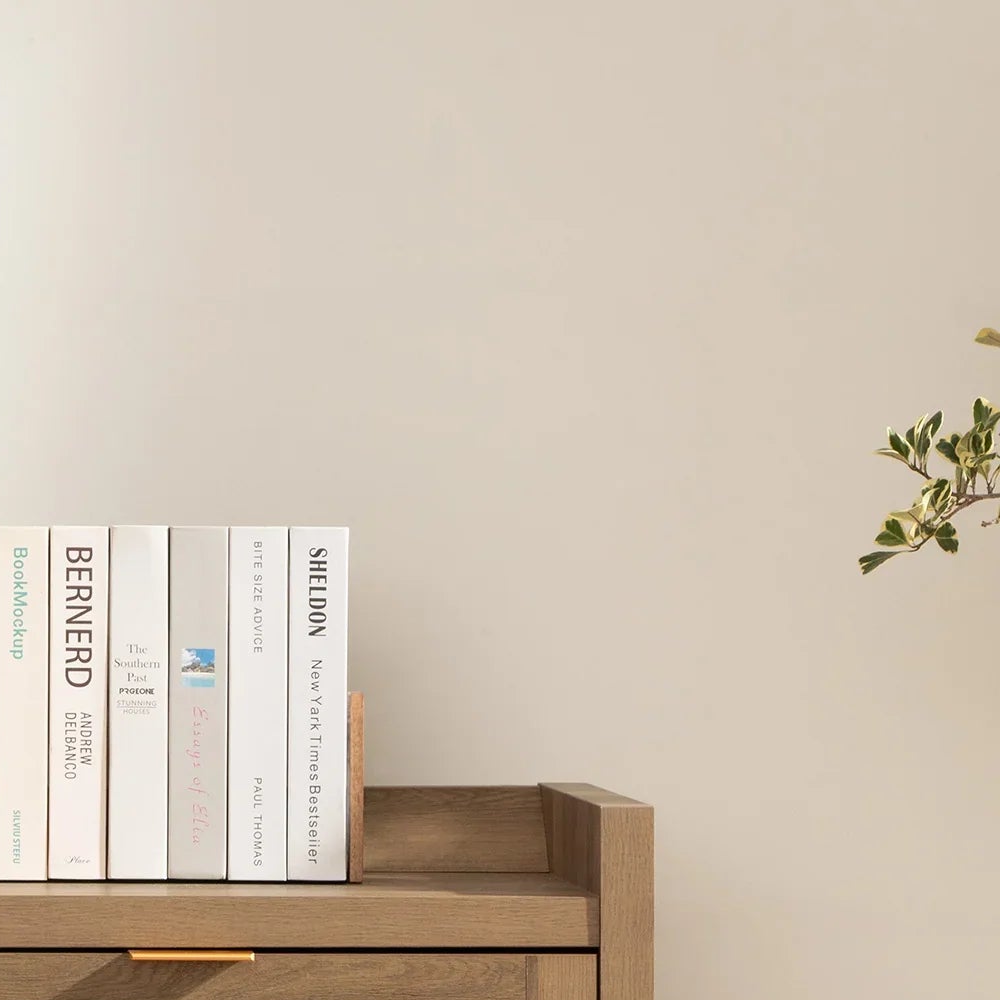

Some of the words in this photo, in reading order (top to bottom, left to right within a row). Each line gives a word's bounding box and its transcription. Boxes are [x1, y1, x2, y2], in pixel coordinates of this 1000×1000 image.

[253, 541, 263, 569] BITE
[9, 547, 28, 660] BookMockup
[253, 574, 263, 602] SIZE
[308, 547, 328, 637] SHELDON
[65, 546, 93, 688] BERNERD
[253, 607, 263, 653] ADVICE
[114, 658, 160, 669] Southern
[126, 643, 148, 654] The
[127, 672, 147, 682] Past
[310, 659, 323, 692] New
[116, 699, 157, 707] STUNNING
[64, 712, 77, 780] DELBANCO
[79, 711, 92, 766] ANDREW
[186, 706, 209, 768] Essays
[309, 735, 322, 781] Times
[187, 777, 209, 797] of
[253, 777, 263, 809] PAUL
[253, 814, 263, 867] THOMAS
